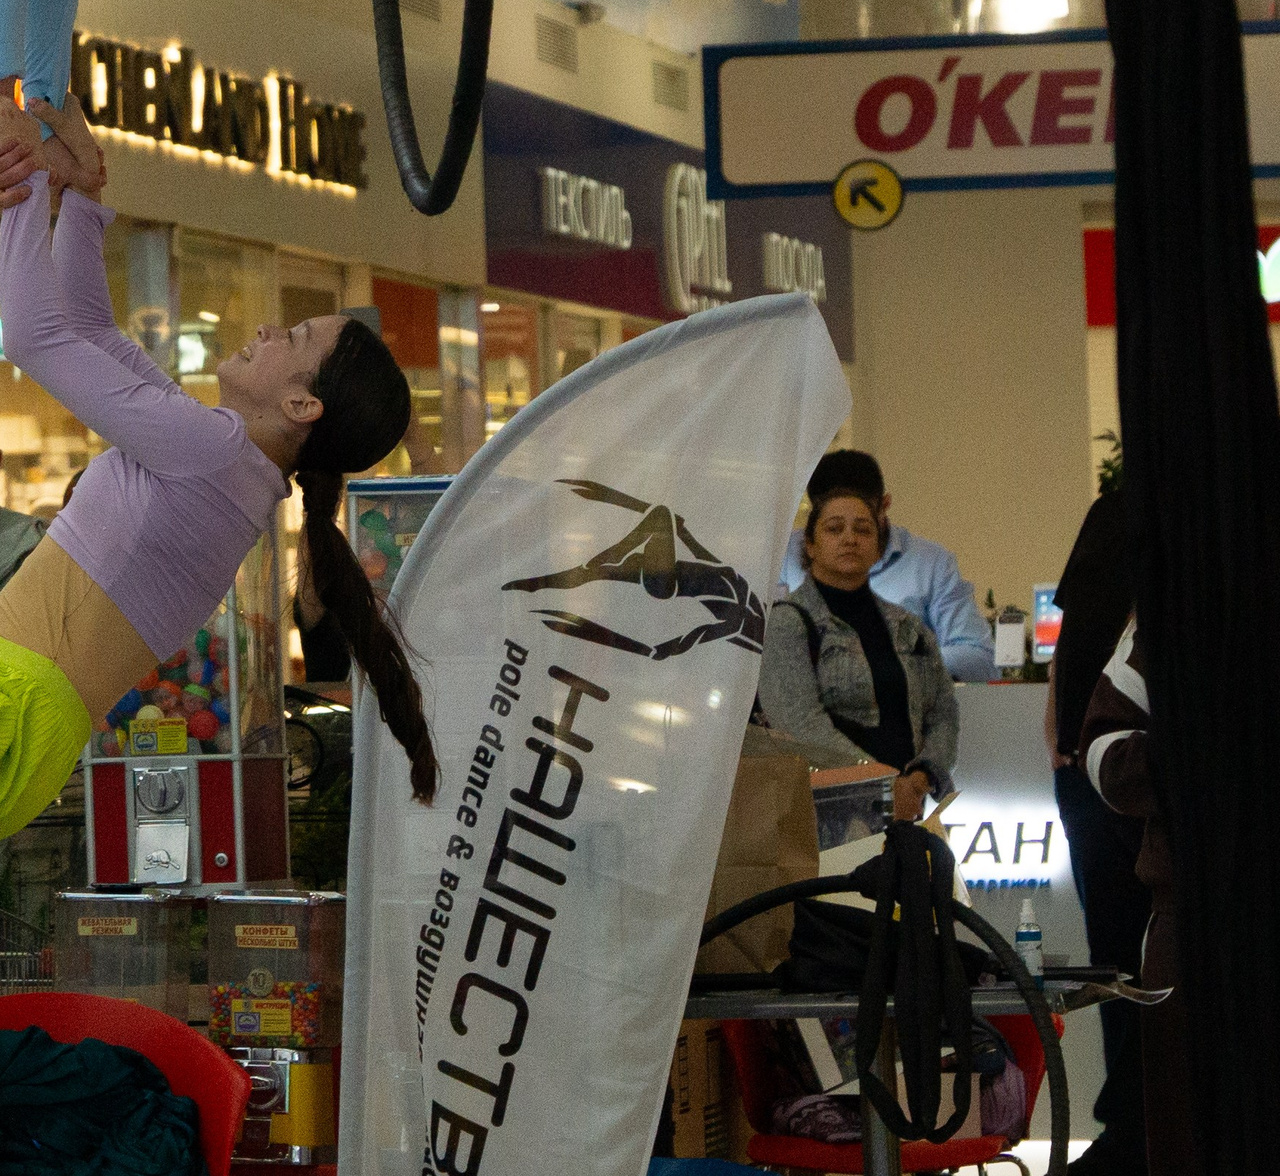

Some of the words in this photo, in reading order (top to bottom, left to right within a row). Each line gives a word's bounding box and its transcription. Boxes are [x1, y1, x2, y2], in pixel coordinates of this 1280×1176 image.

[853, 54, 1117, 154] О'КЕ
[541, 166, 634, 251] ТЕКСТИЛЬ
[490, 639, 529, 717] pole
[456, 724, 504, 829] dance
[446, 835, 475, 860] &
[91, 926, 124, 935] РЕЗИНКА
[238, 937, 276, 946] НЕСКОЛЬКО
[277, 938, 298, 947] ШТУК
[242, 927, 289, 936] КОНФЕТЫ
[251, 971, 266, 988] 10
